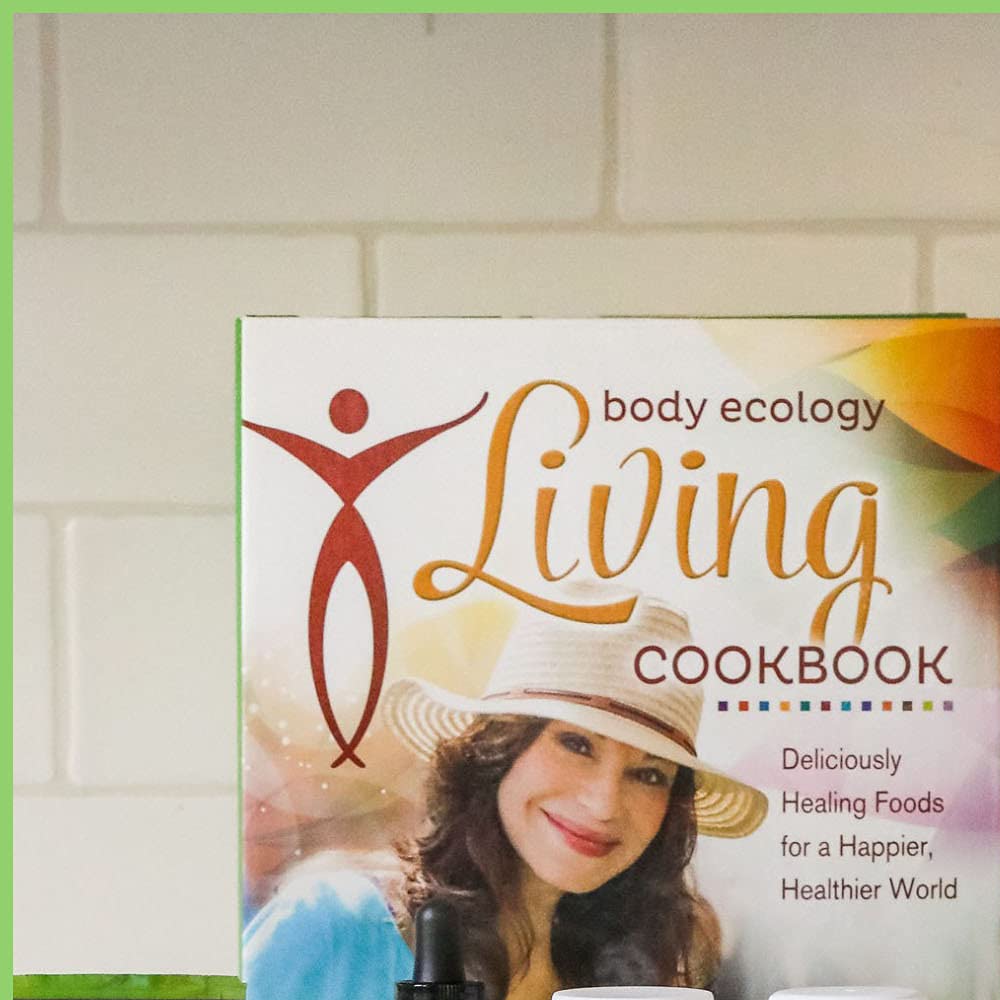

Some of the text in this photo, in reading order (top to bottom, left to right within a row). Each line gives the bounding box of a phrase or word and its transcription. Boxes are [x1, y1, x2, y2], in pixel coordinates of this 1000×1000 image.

[603, 389, 885, 432] body ecology
[412, 379, 893, 645] Living
[633, 645, 954, 685] COOKBOOK
[781, 746, 902, 777] Deliciously
[781, 790, 945, 818] Healing Foods
[780, 833, 934, 862] for a Happier,
[781, 876, 959, 902] Healthier World
